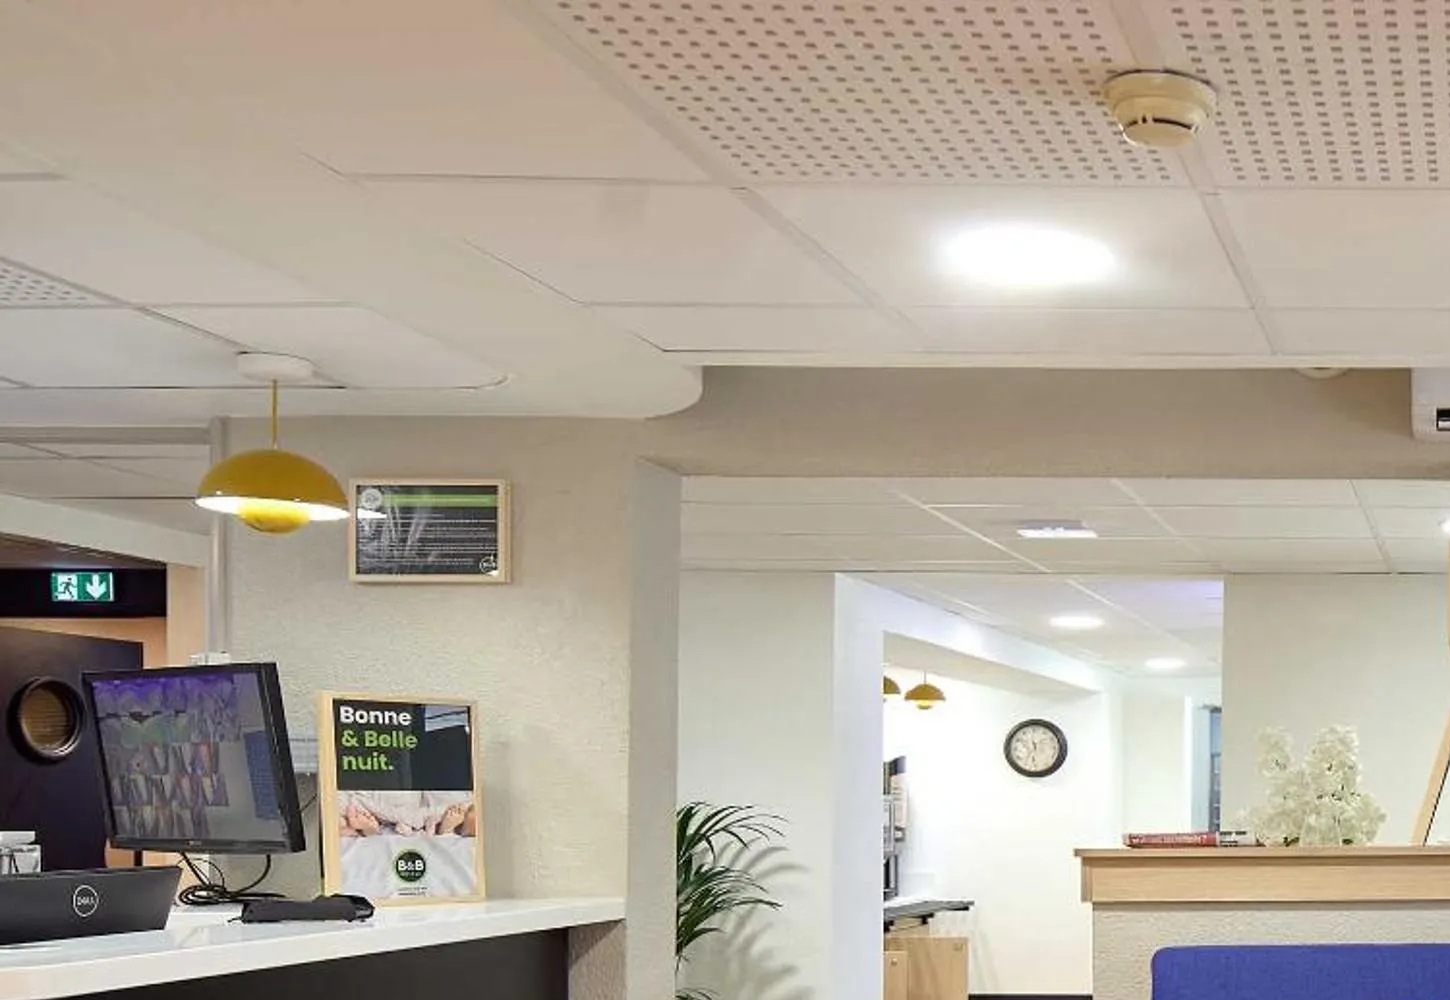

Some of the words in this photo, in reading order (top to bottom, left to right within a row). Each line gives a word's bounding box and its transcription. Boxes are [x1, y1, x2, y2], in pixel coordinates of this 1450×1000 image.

[340, 706, 412, 726] Bonne
[341, 730, 360, 748] &
[364, 731, 418, 749] Belle
[342, 752, 394, 770] nuit.
[398, 859, 424, 871] B&B
